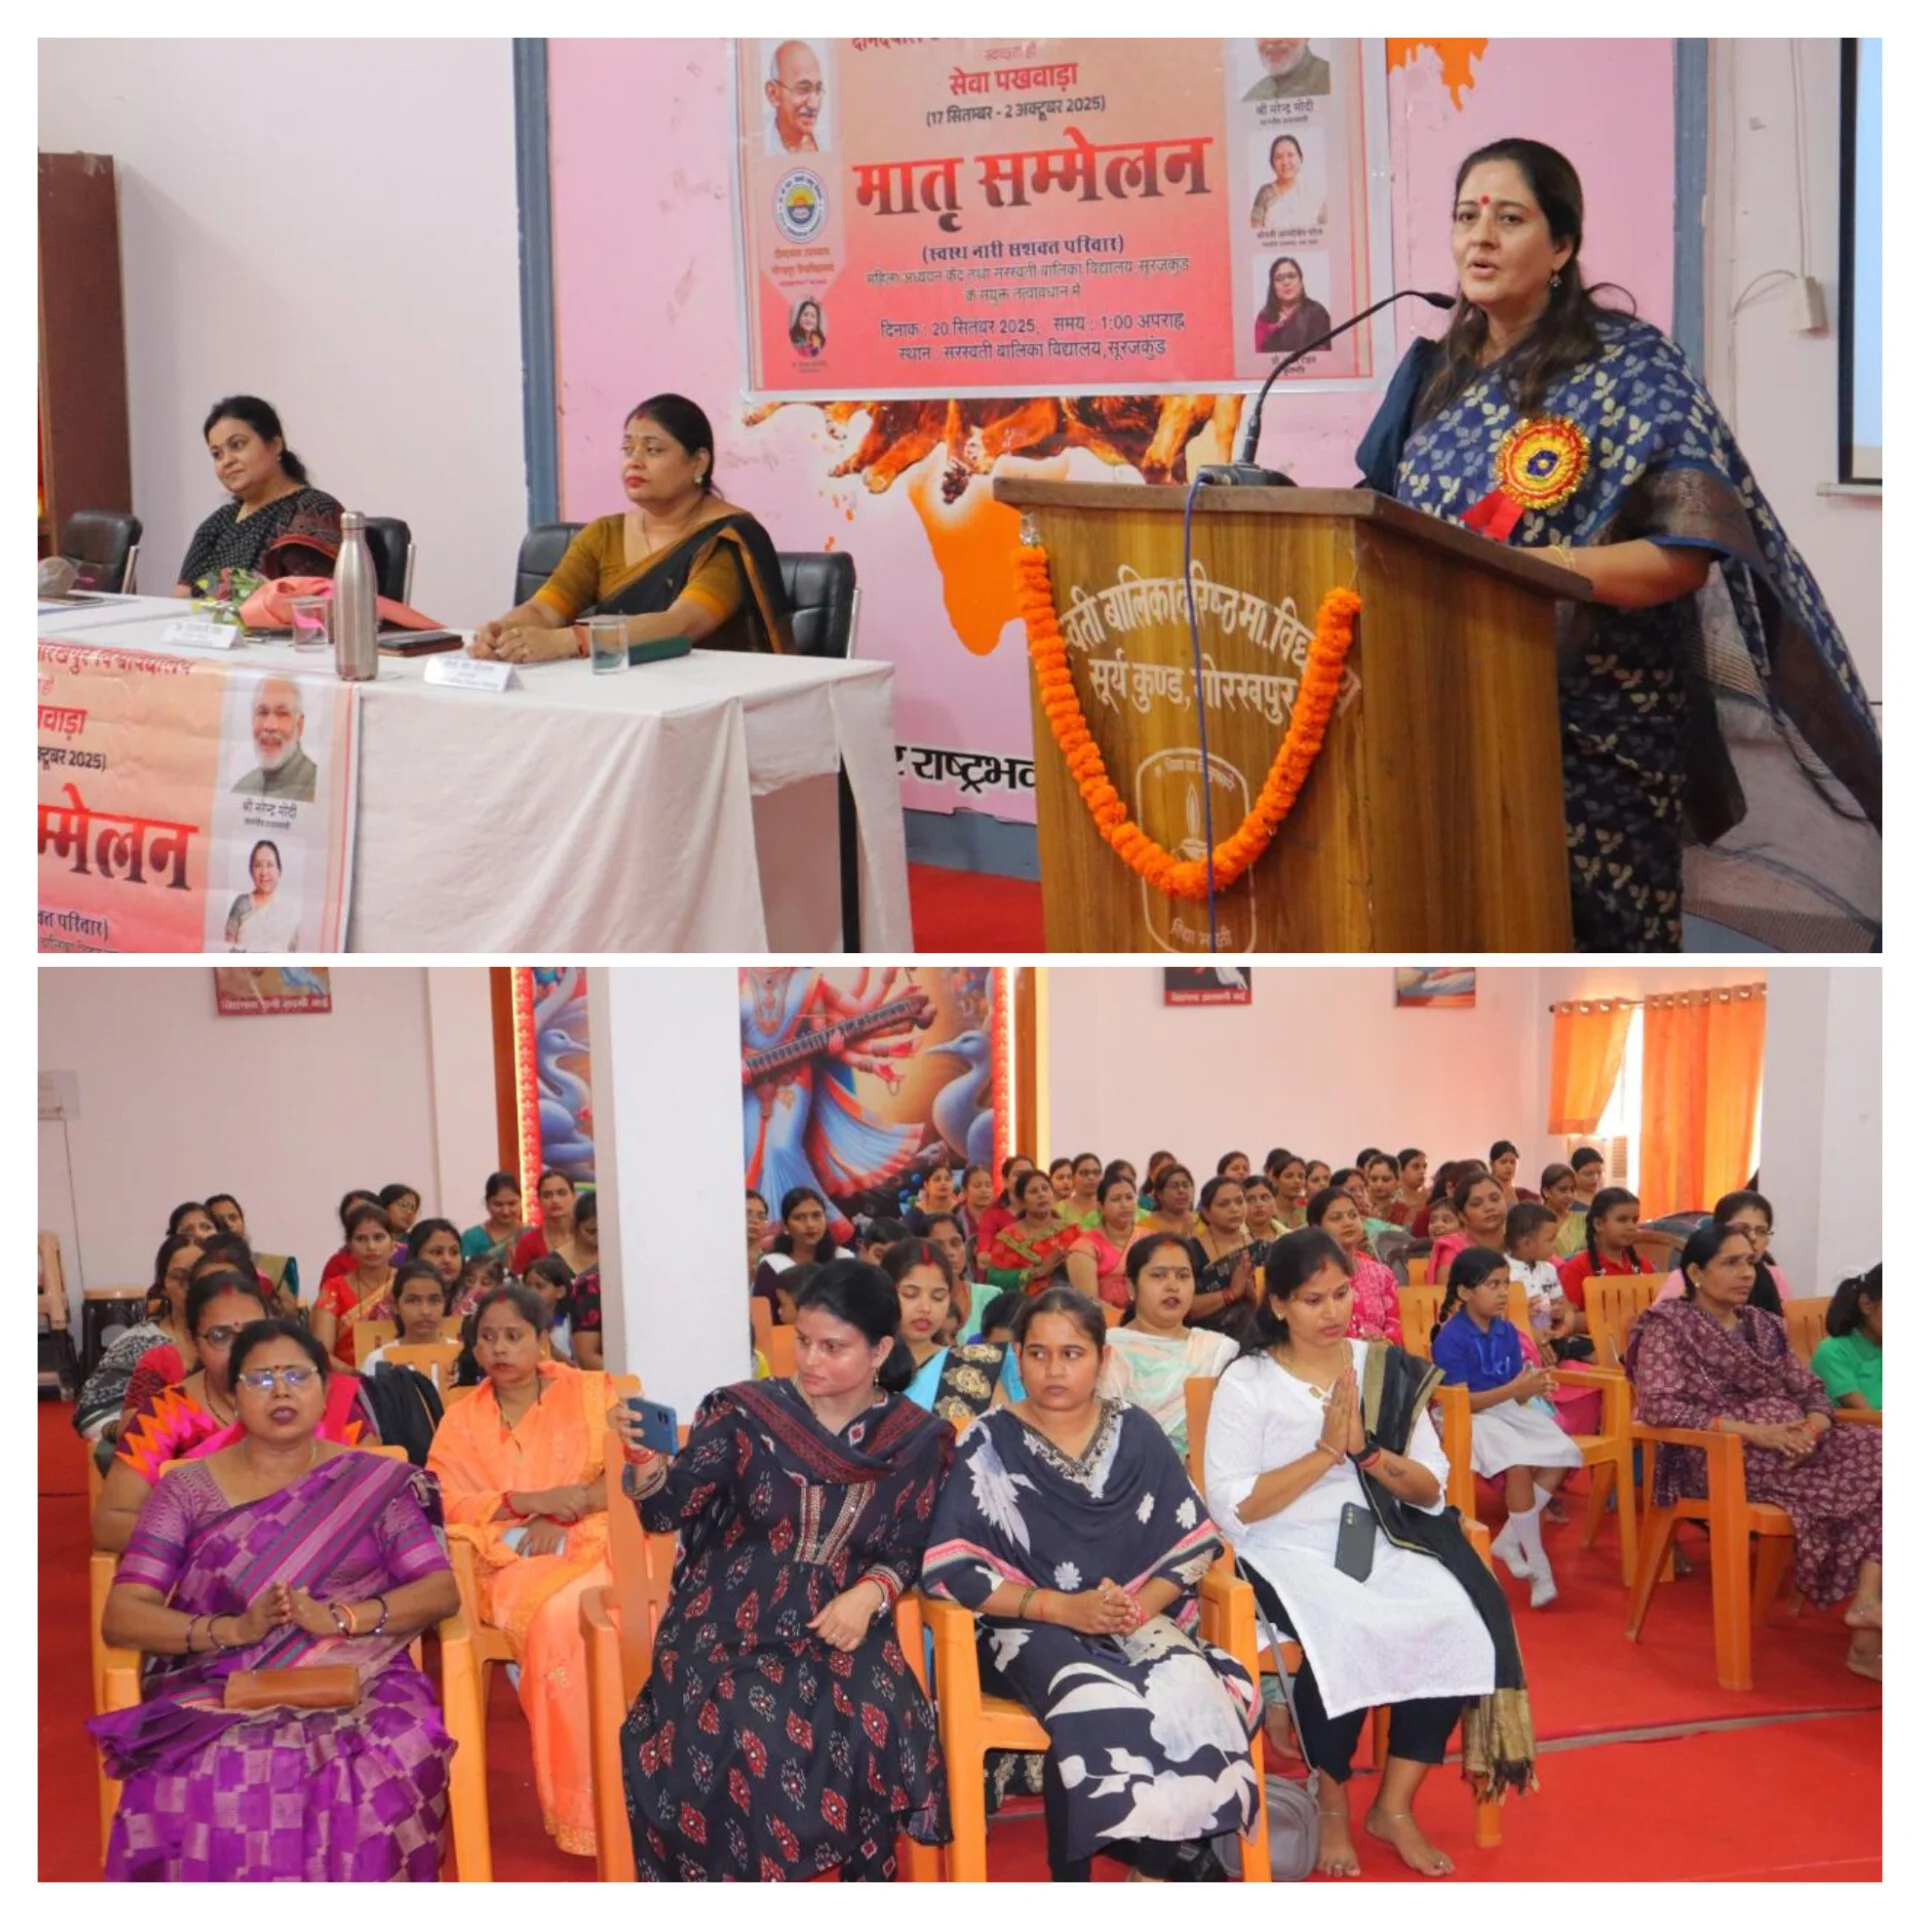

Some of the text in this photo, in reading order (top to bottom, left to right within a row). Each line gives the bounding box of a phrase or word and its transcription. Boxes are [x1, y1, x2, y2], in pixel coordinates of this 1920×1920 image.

[949, 62, 1079, 96] सेवा पखवाड़ा
[926, 110, 943, 128] (17
[1005, 103, 1013, 118] 2
[1066, 94, 1106, 113] 2025)
[852, 157, 964, 233] मातृ
[975, 126, 1213, 208] सम्मेलन
[973, 239, 1004, 259] नारी
[1064, 234, 1125, 255] परिवार)
[932, 321, 949, 336] 20
[1053, 315, 1086, 332] समय
[1101, 314, 1133, 330] 1:00
[898, 344, 931, 361] स्थान
[944, 340, 992, 360] सरस्वती
[1098, 564, 1178, 633] बालिका
[1088, 648, 1130, 714] सूर्य
[69, 749, 107, 772] 2025)
